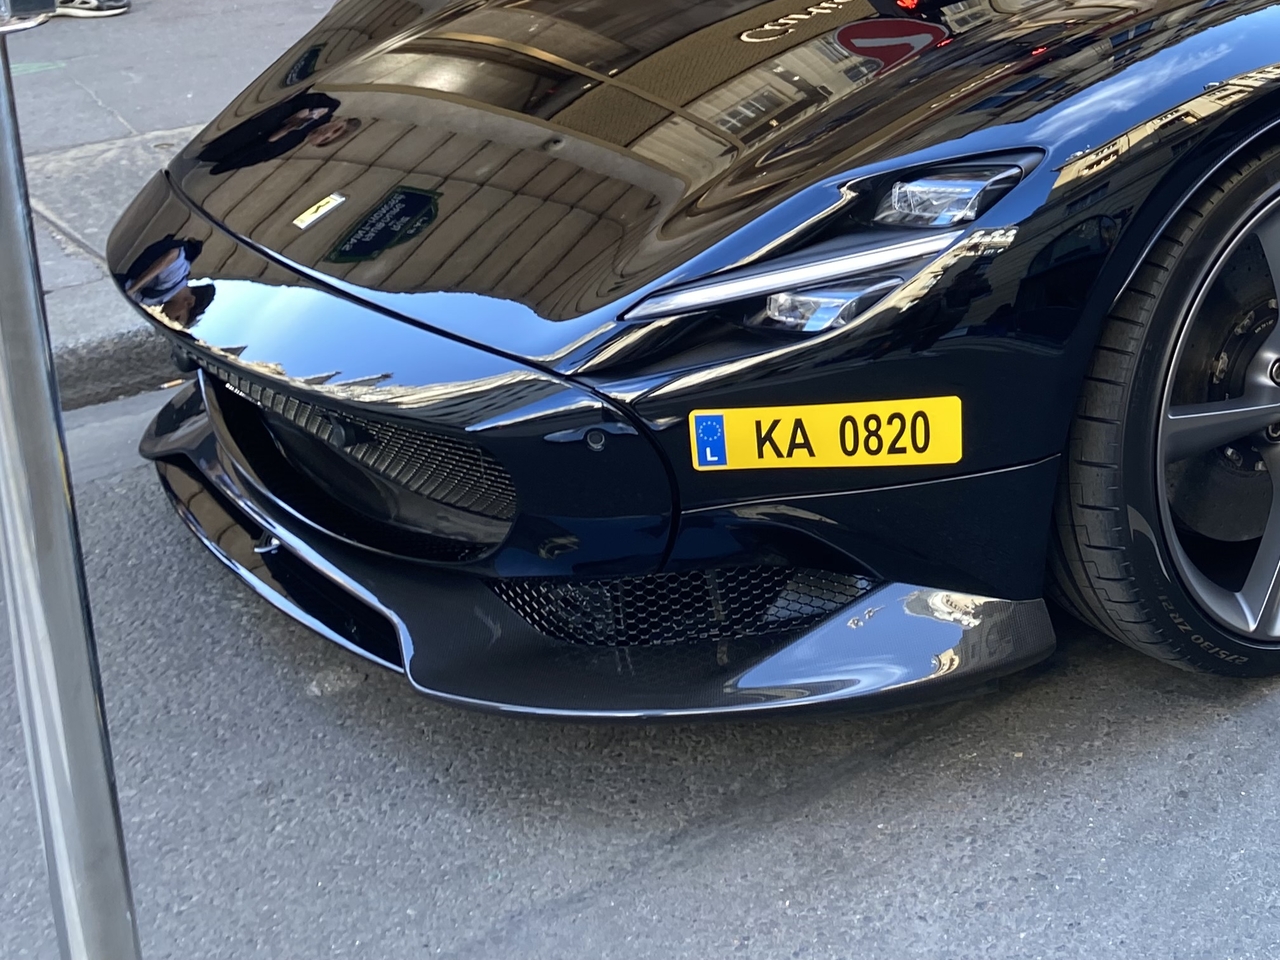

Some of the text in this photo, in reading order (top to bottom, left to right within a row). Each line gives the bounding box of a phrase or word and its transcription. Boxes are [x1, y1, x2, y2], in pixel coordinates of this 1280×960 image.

[705, 409, 931, 462] L KA 0820
